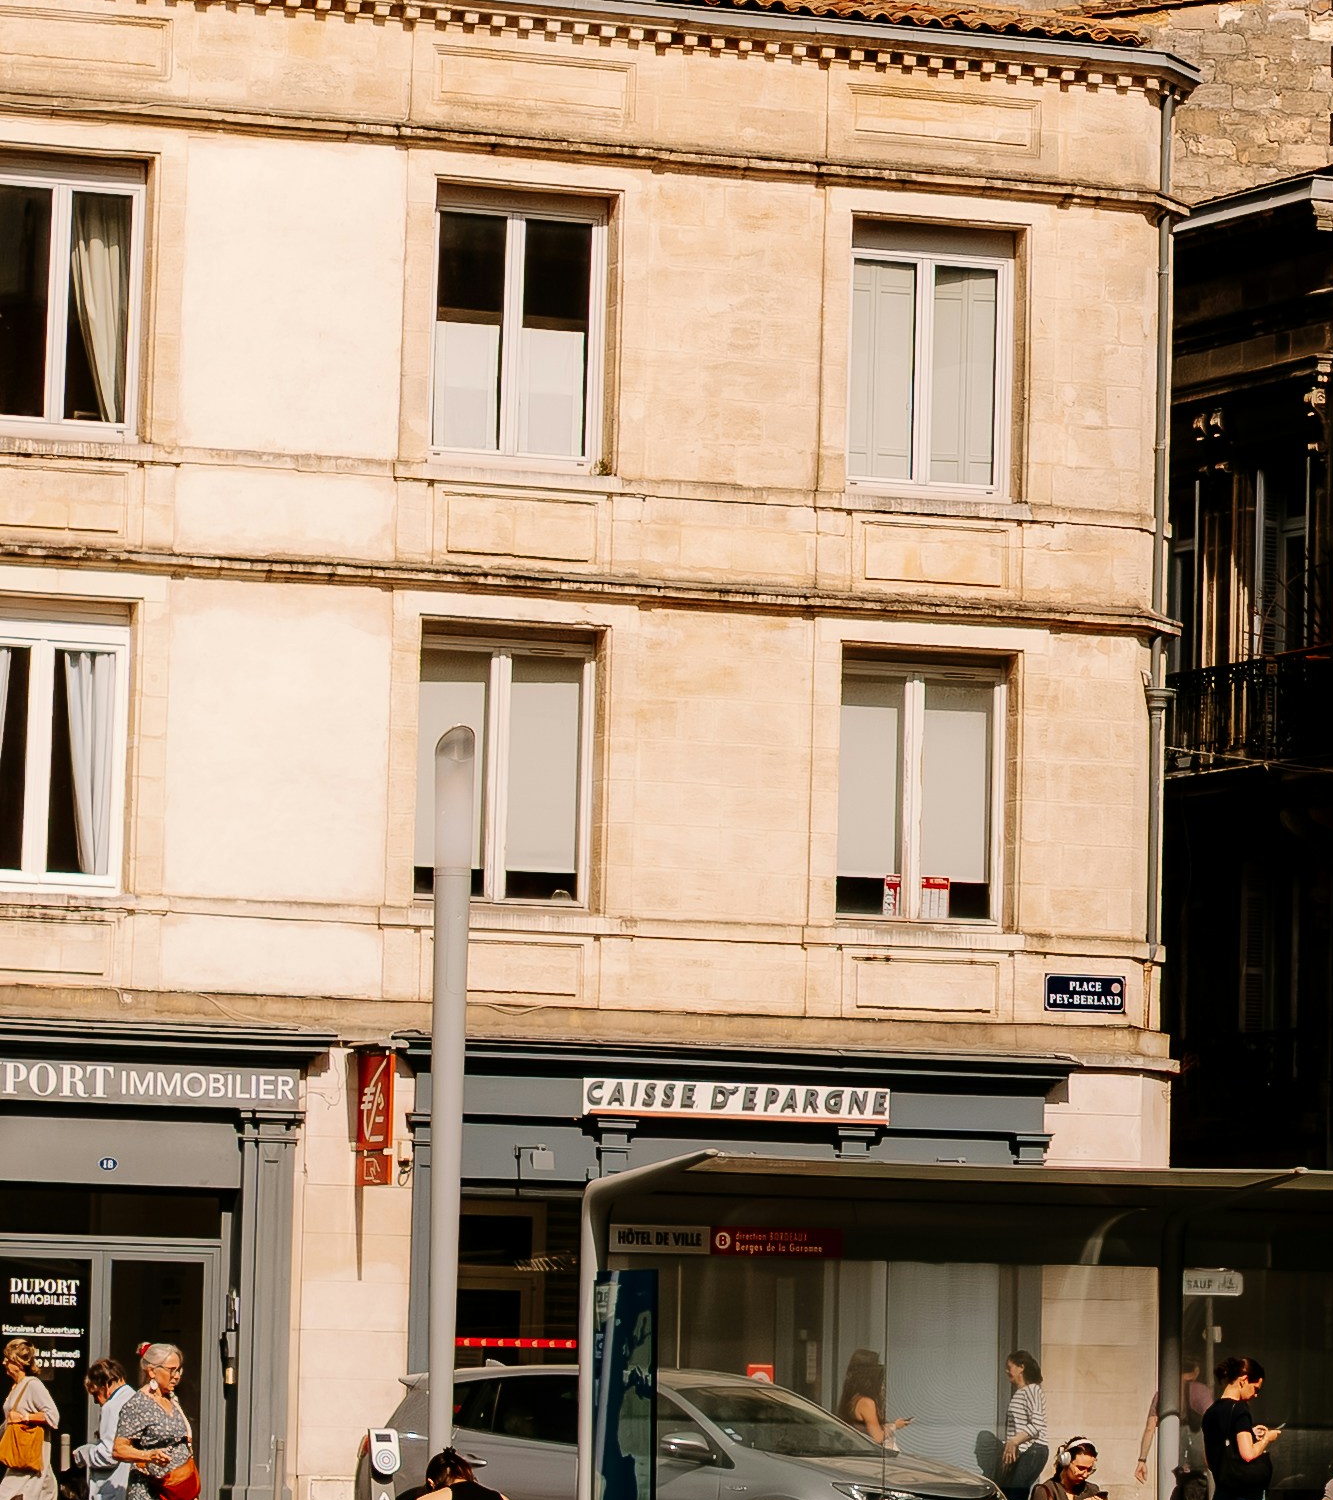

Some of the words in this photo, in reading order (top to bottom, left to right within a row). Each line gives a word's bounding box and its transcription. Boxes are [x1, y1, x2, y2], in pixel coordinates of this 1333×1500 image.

[1069, 981, 1102, 992] PLACE
[1049, 994, 1121, 1005] PEY-BERLAND
[0, 1061, 115, 1098] PORT
[121, 1070, 295, 1100] IMMOBILIER
[586, 1081, 697, 1109] CAISSE
[617, 1227, 652, 1246] HÔTEL
[656, 1231, 669, 1246] DE
[672, 1232, 702, 1247] VILLE
[735, 1231, 767, 1241] direction
[735, 1242, 763, 1254] Berges
[766, 1243, 777, 1252] de
[779, 1244, 786, 1252] la
[789, 1243, 823, 1253] Garonne
[10, 1278, 79, 1294] DUPORT
[11, 1294, 77, 1306] IMMOBILIER
[2, 1324, 34, 1333] Horaires
[35, 1325, 80, 1335] d'ouverture
[52, 1349, 80, 1359] Samedi
